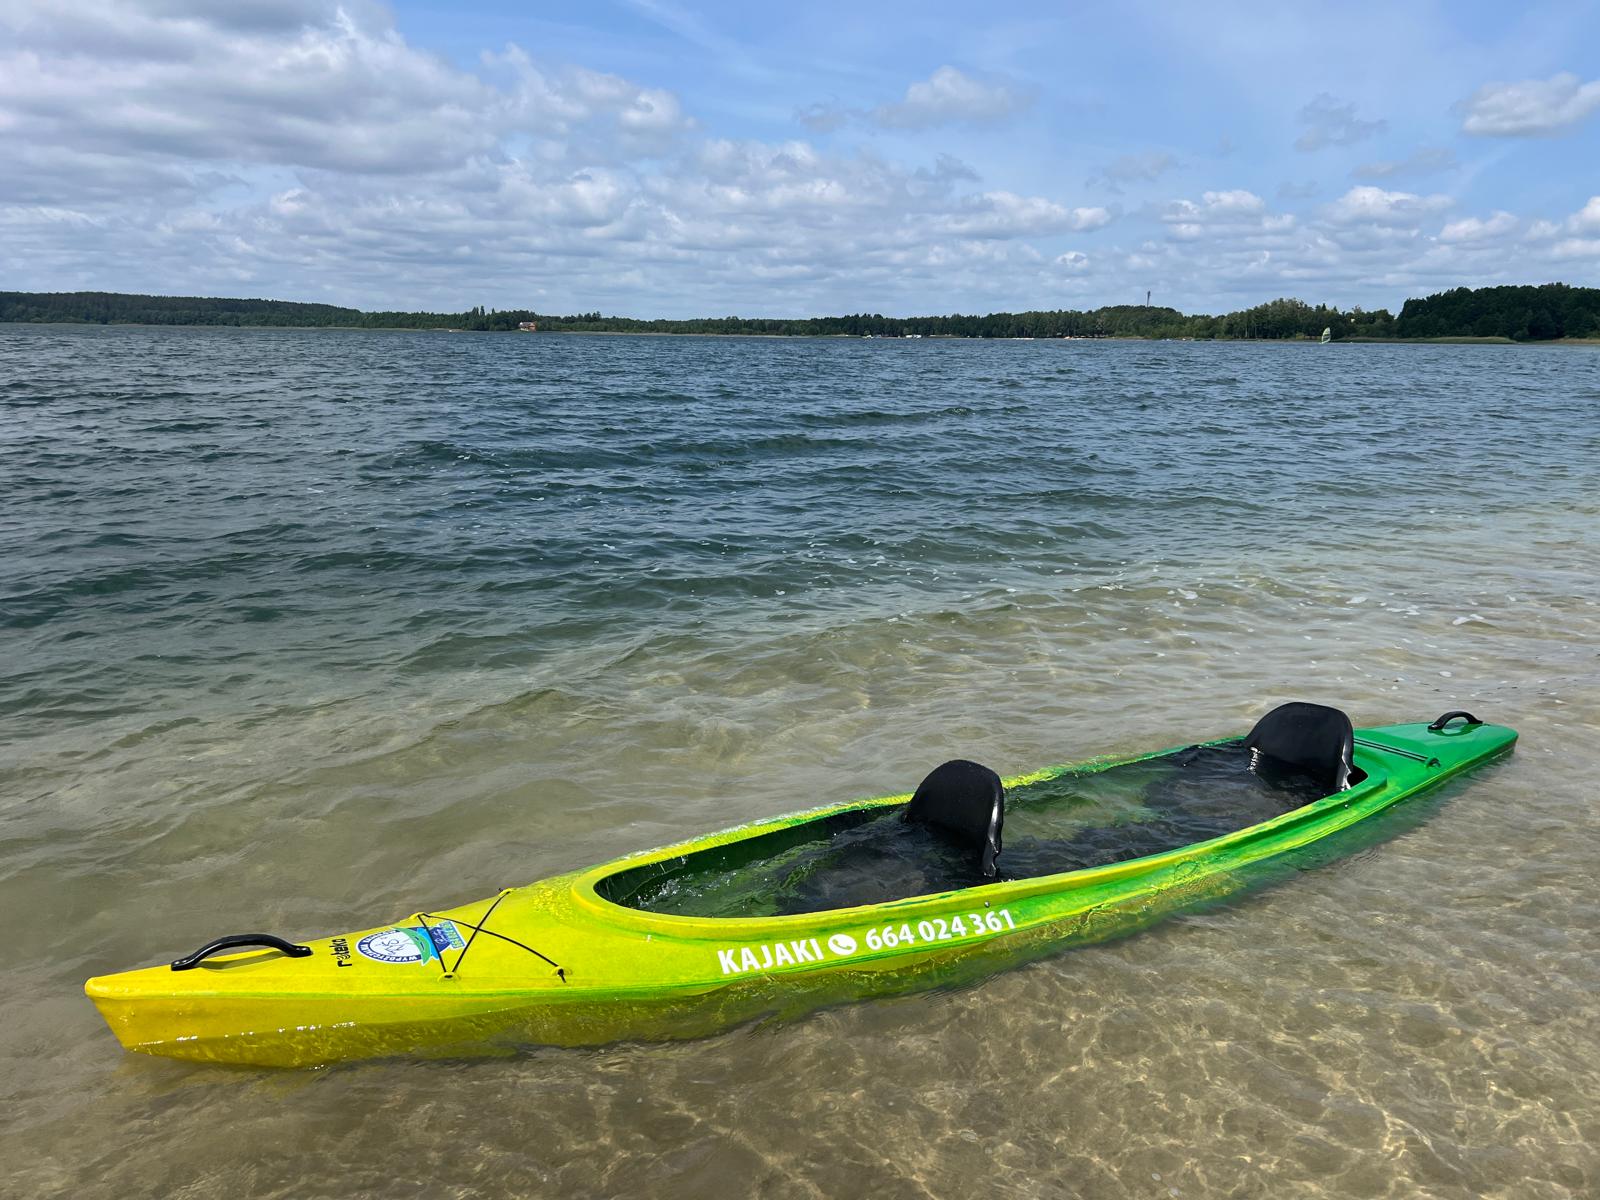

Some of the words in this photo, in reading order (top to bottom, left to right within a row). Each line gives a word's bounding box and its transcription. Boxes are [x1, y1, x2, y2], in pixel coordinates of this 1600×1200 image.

[717, 938, 825, 975] KAJAKI
[865, 923, 915, 952] 664
[918, 915, 967, 943] 024
[967, 909, 1016, 936] 361
